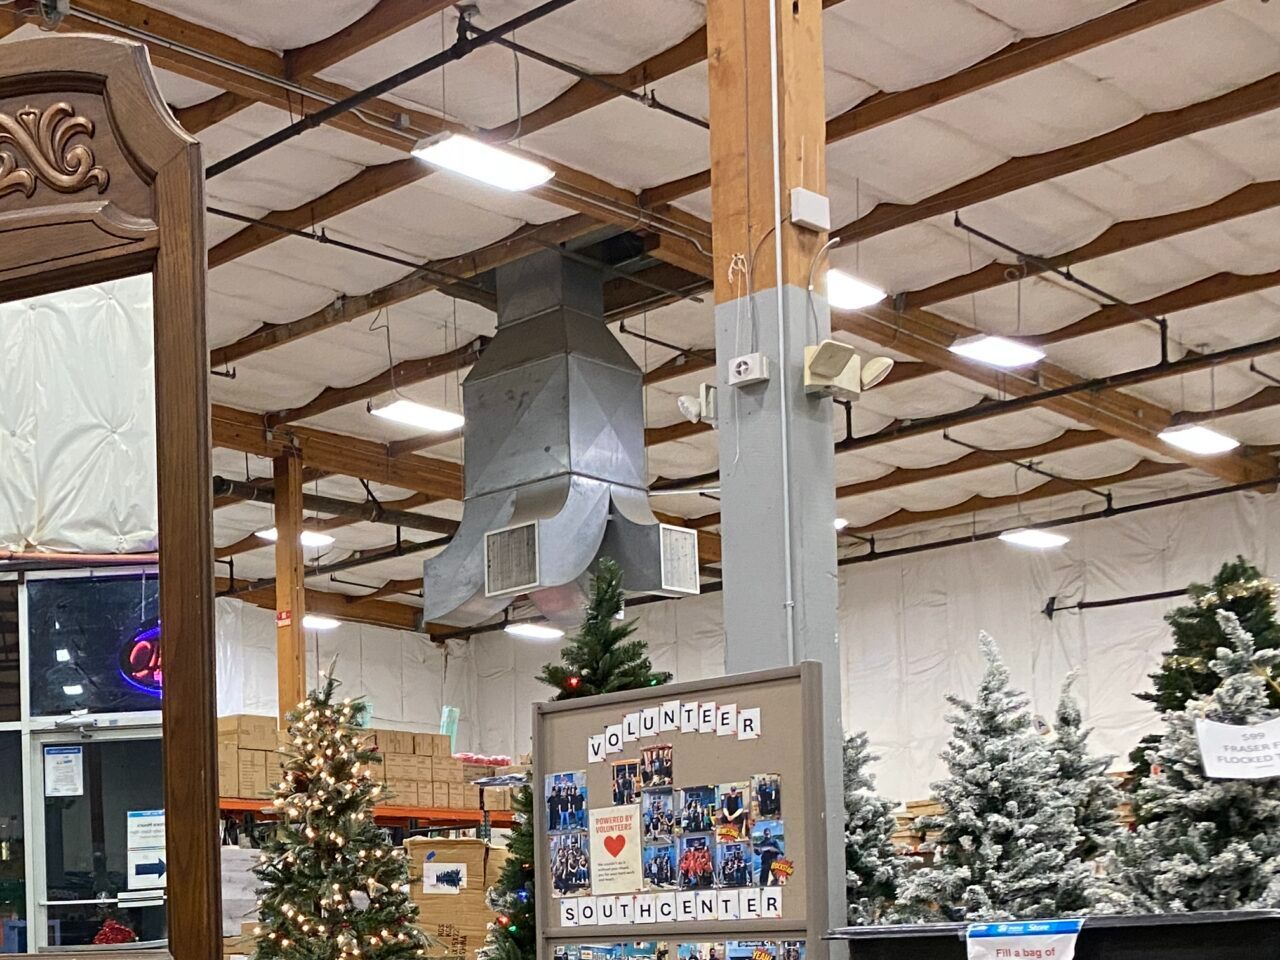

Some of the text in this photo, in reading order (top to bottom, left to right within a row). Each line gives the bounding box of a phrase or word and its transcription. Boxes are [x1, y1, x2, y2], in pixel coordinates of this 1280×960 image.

[591, 708, 754, 757] VOLUNTEER
[1217, 754, 1273, 764] FLOCKED
[595, 816, 624, 825] POWERED
[595, 823, 632, 834] VOLUNTEERS
[565, 896, 778, 921] SOUTHCENTER
[996, 948, 1011, 957] Fill
[1023, 949, 1042, 958] bag
[1046, 947, 1055, 956] of
